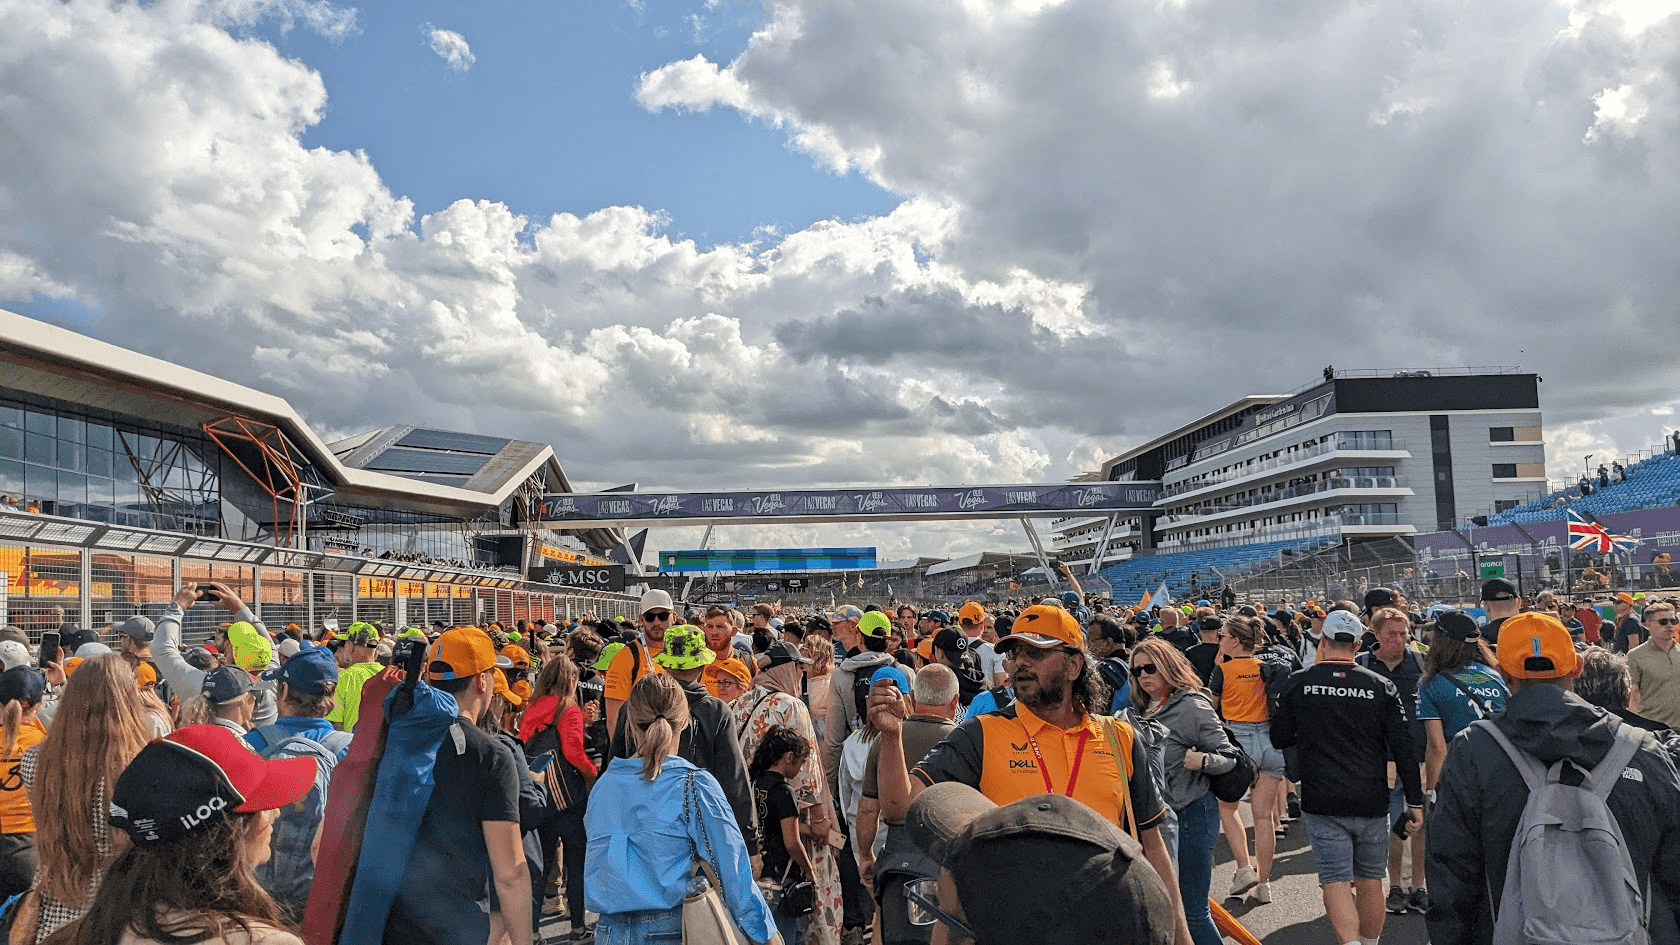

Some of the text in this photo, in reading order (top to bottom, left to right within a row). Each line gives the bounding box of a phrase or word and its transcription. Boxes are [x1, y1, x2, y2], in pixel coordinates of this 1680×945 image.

[648, 497, 683, 515] Vegas
[752, 495, 786, 513] Vegas
[854, 493, 888, 511] Vegas
[955, 491, 988, 509] Vegas
[1073, 488, 1107, 506] Vegas
[545, 499, 579, 518] Vegas
[567, 569, 610, 585] MSC
[1254, 653, 1293, 661] PETROAS
[578, 681, 603, 691] RONAS
[1303, 685, 1375, 699] PETRONAS
[1009, 760, 1037, 768] DELL
[180, 796, 228, 830] iLOQ
